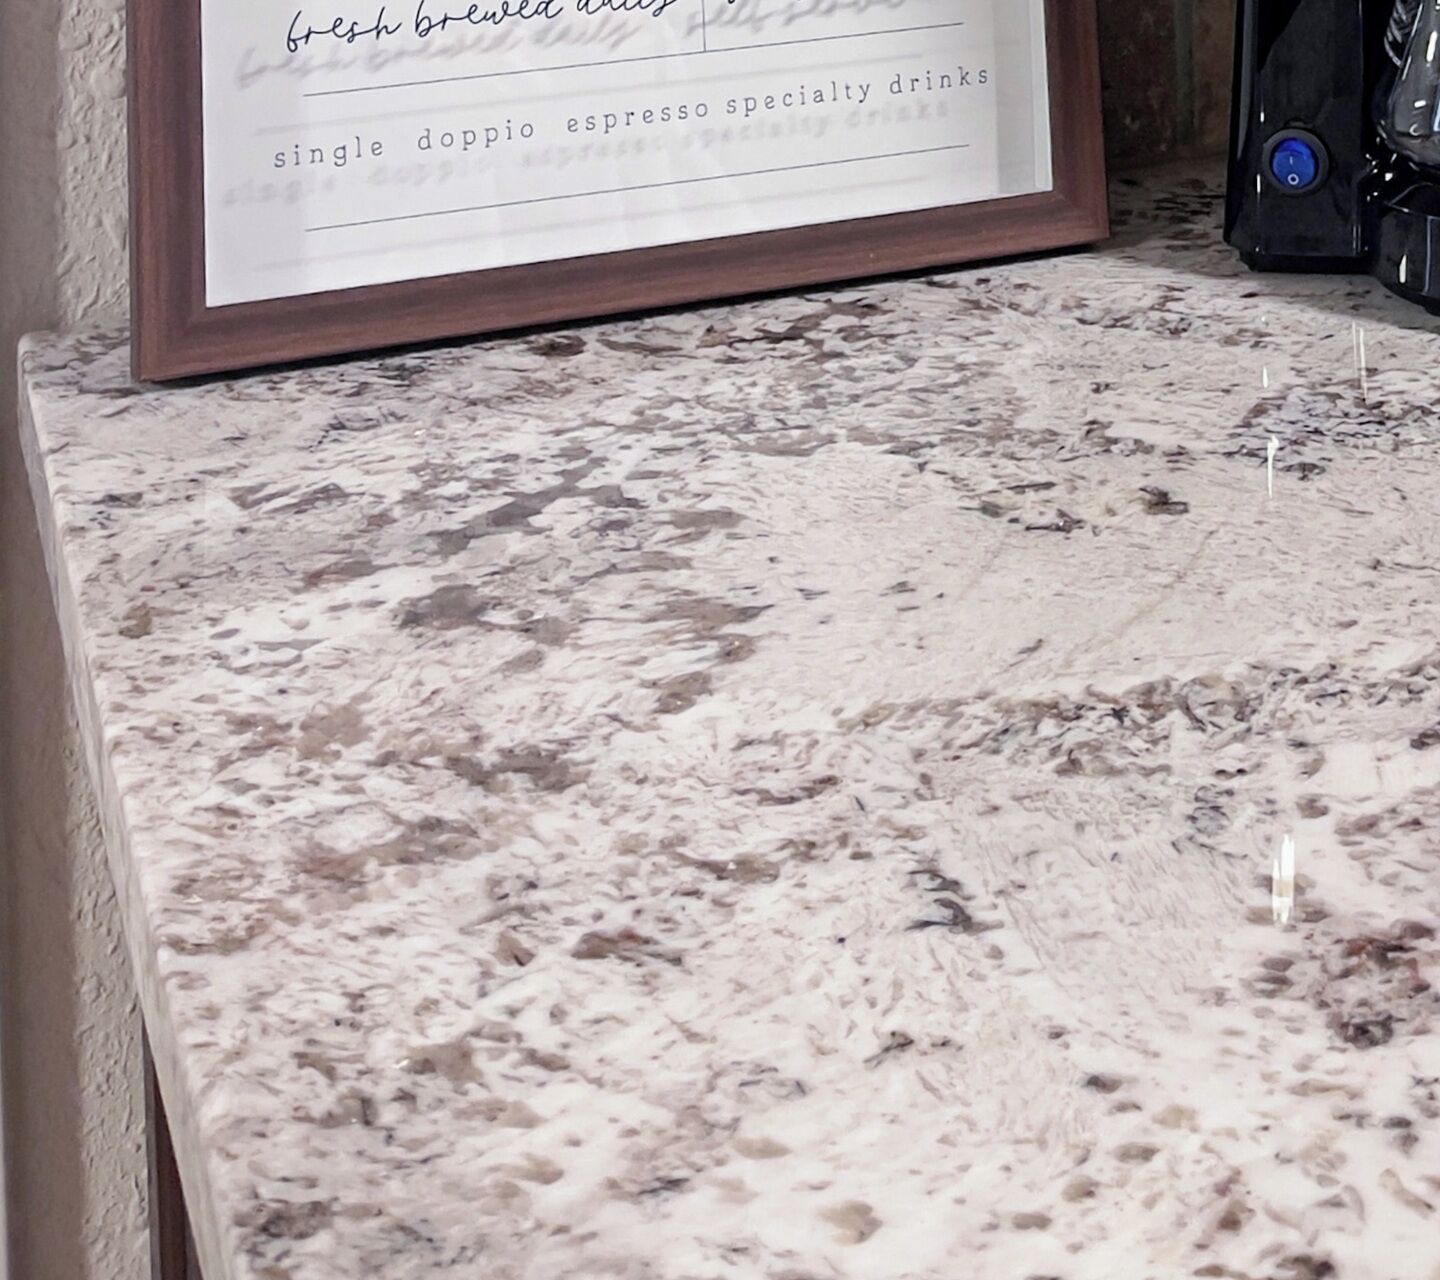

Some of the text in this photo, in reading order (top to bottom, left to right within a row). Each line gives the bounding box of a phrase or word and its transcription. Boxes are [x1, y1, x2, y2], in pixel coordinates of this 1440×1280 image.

[286, 10, 402, 53] fresh
[273, 66, 990, 168] single doppio espresso specialty drinks
